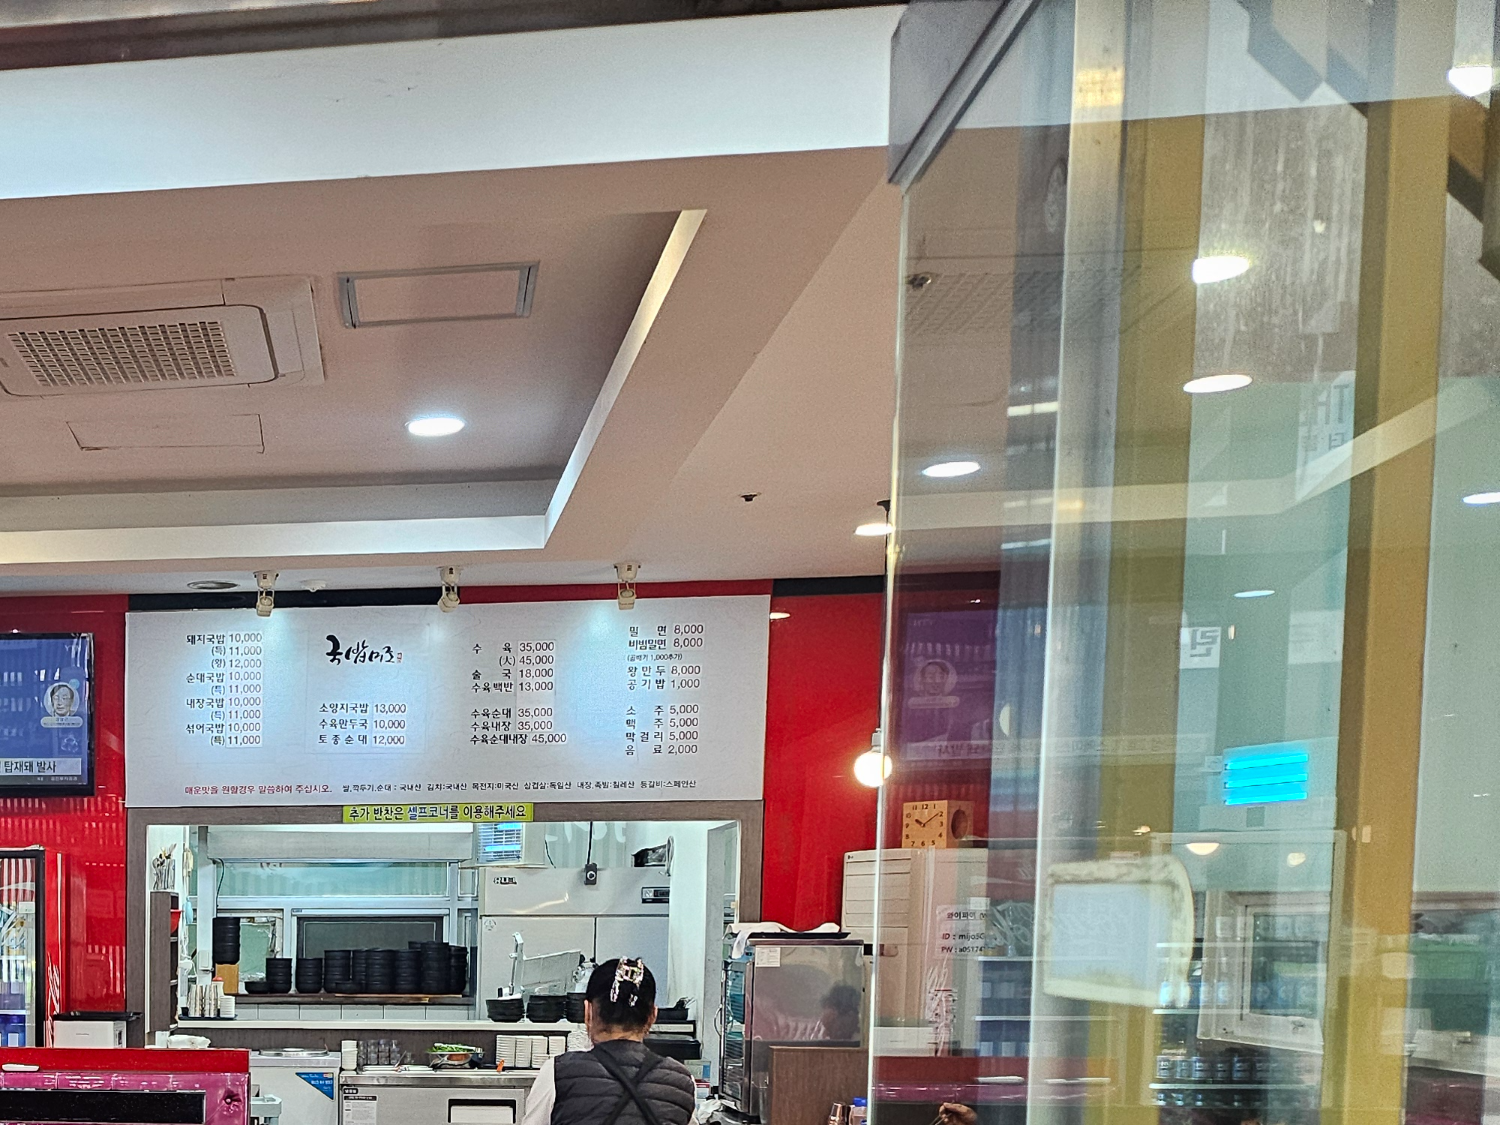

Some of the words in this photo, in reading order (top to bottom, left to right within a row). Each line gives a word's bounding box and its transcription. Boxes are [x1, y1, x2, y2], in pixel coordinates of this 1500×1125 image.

[673, 624, 704, 636] 8,000
[186, 634, 225, 645] 돼지국밥
[229, 632, 262, 644] 10,000
[628, 638, 667, 650] 비빔밀면
[673, 637, 703, 649] 8,000
[229, 646, 262, 656] 11,000
[519, 642, 554, 653] 35,000
[229, 658, 262, 669] 12,000
[519, 655, 554, 666] 45,000
[519, 668, 554, 679] 18,000
[671, 665, 701, 676] 8,000
[186, 672, 225, 683] 순대국밥
[229, 671, 261, 682] 10,000
[229, 684, 261, 695] 11,000
[519, 681, 554, 692] 13,000
[671, 678, 700, 690] 1,000
[186, 698, 225, 709] 내장국밥
[228, 697, 261, 708] 10,000
[228, 709, 261, 720] 11,000
[319, 703, 369, 714] 소양지국밥
[374, 703, 407, 715] 13,000
[471, 708, 512, 719] 수육순대
[517, 707, 553, 718] 35,000
[669, 704, 699, 715] 5,000
[185, 723, 225, 734] 섞어국밥
[228, 722, 261, 733] 10,000
[319, 718, 368, 730] 수육만두국
[373, 719, 406, 730] 10,000
[470, 721, 512, 732] 수육내장
[517, 720, 552, 731] 35,000
[669, 717, 699, 728] 5,000
[228, 735, 261, 746] 11,000
[373, 735, 405, 746] 12,000
[470, 733, 528, 745] 수육순대내장
[531, 733, 567, 744] 45,000
[669, 730, 699, 741] 5,000
[667, 744, 698, 755] 2,000
[4, 760, 34, 774] 탑재돼
[36, 760, 57, 774] 발사
[184, 785, 218, 795] 매운맛을
[221, 784, 255, 795] 원할경우
[258, 784, 293, 795] 말씀하여
[295, 784, 333, 794] 주십시오.
[349, 806, 370, 821] 추가
[373, 806, 404, 821] 반찬은
[407, 805, 460, 820] 셀프코너를
[463, 805, 527, 819] 이용해주세요
